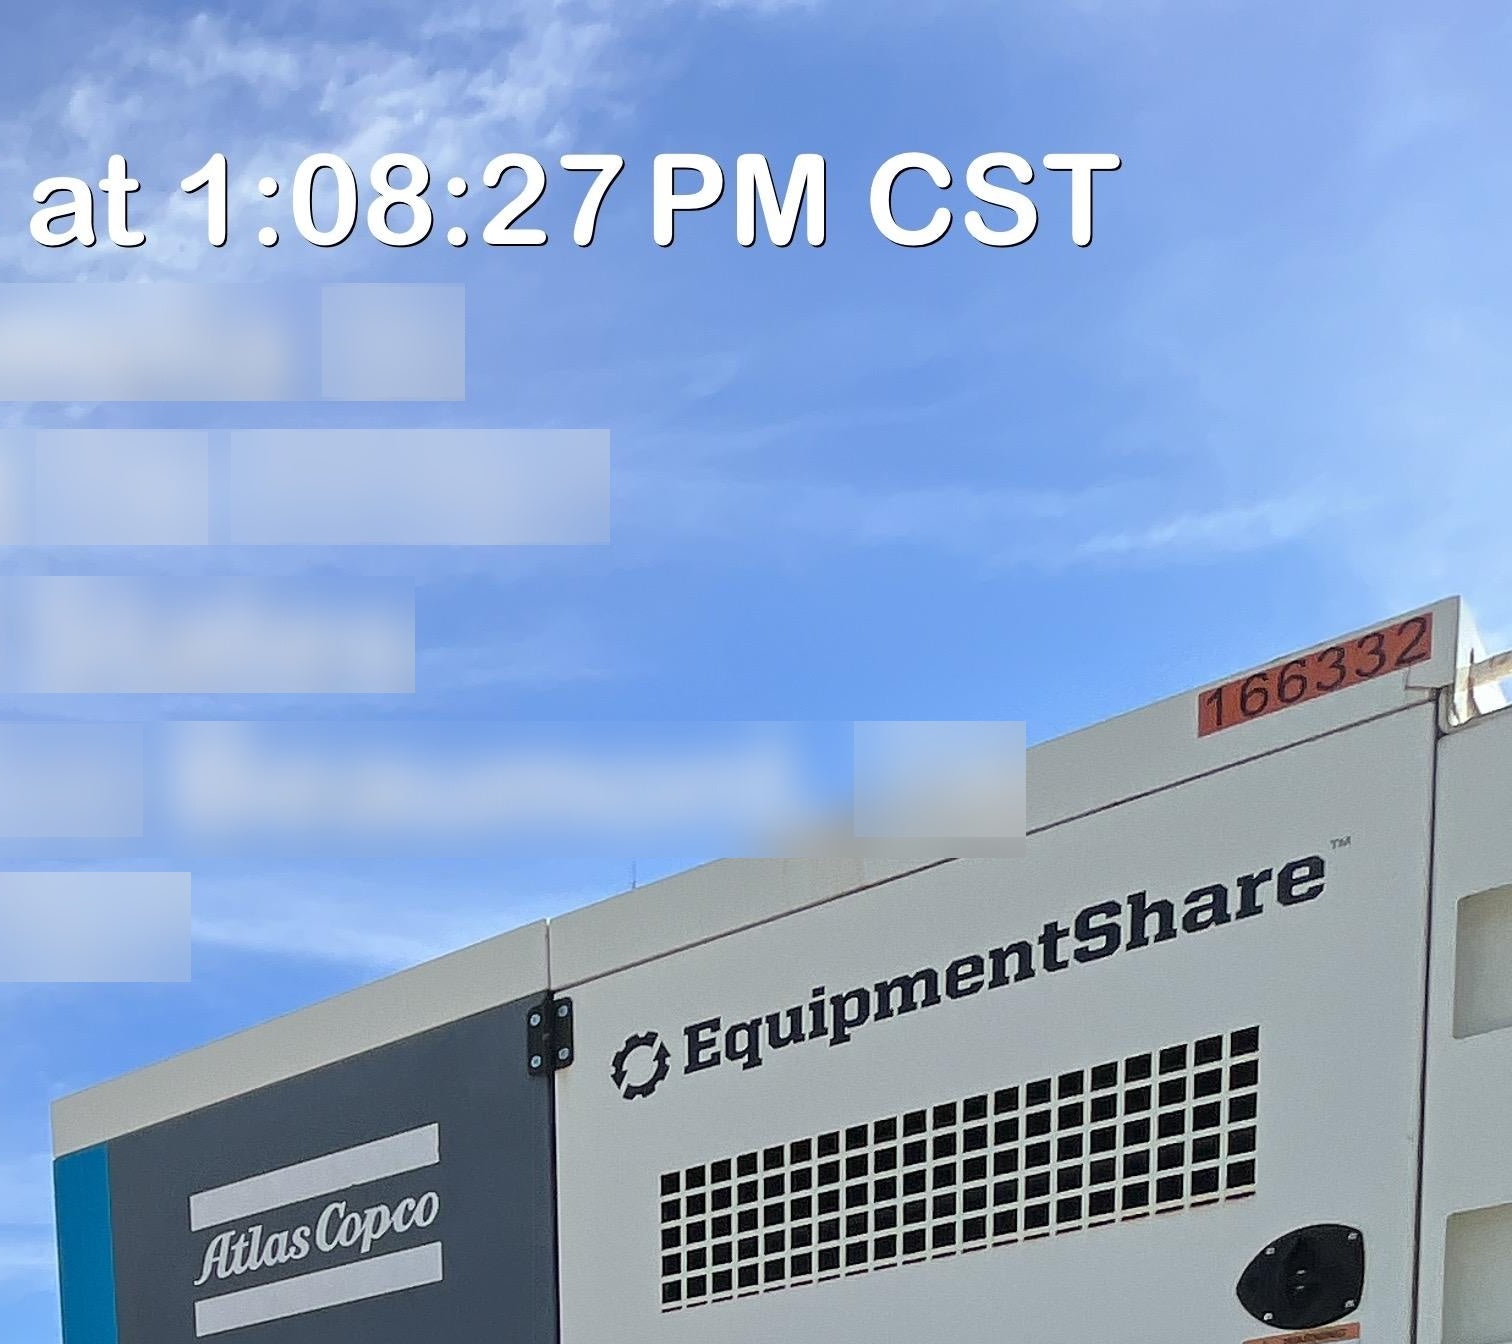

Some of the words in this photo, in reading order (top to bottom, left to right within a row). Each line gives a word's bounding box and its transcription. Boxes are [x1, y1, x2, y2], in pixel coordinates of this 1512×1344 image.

[1206, 616, 1428, 727] 166332
[683, 854, 1327, 1076] EquipmentShare
[193, 1221, 310, 1287] Atlas
[315, 1190, 441, 1255] Copco
